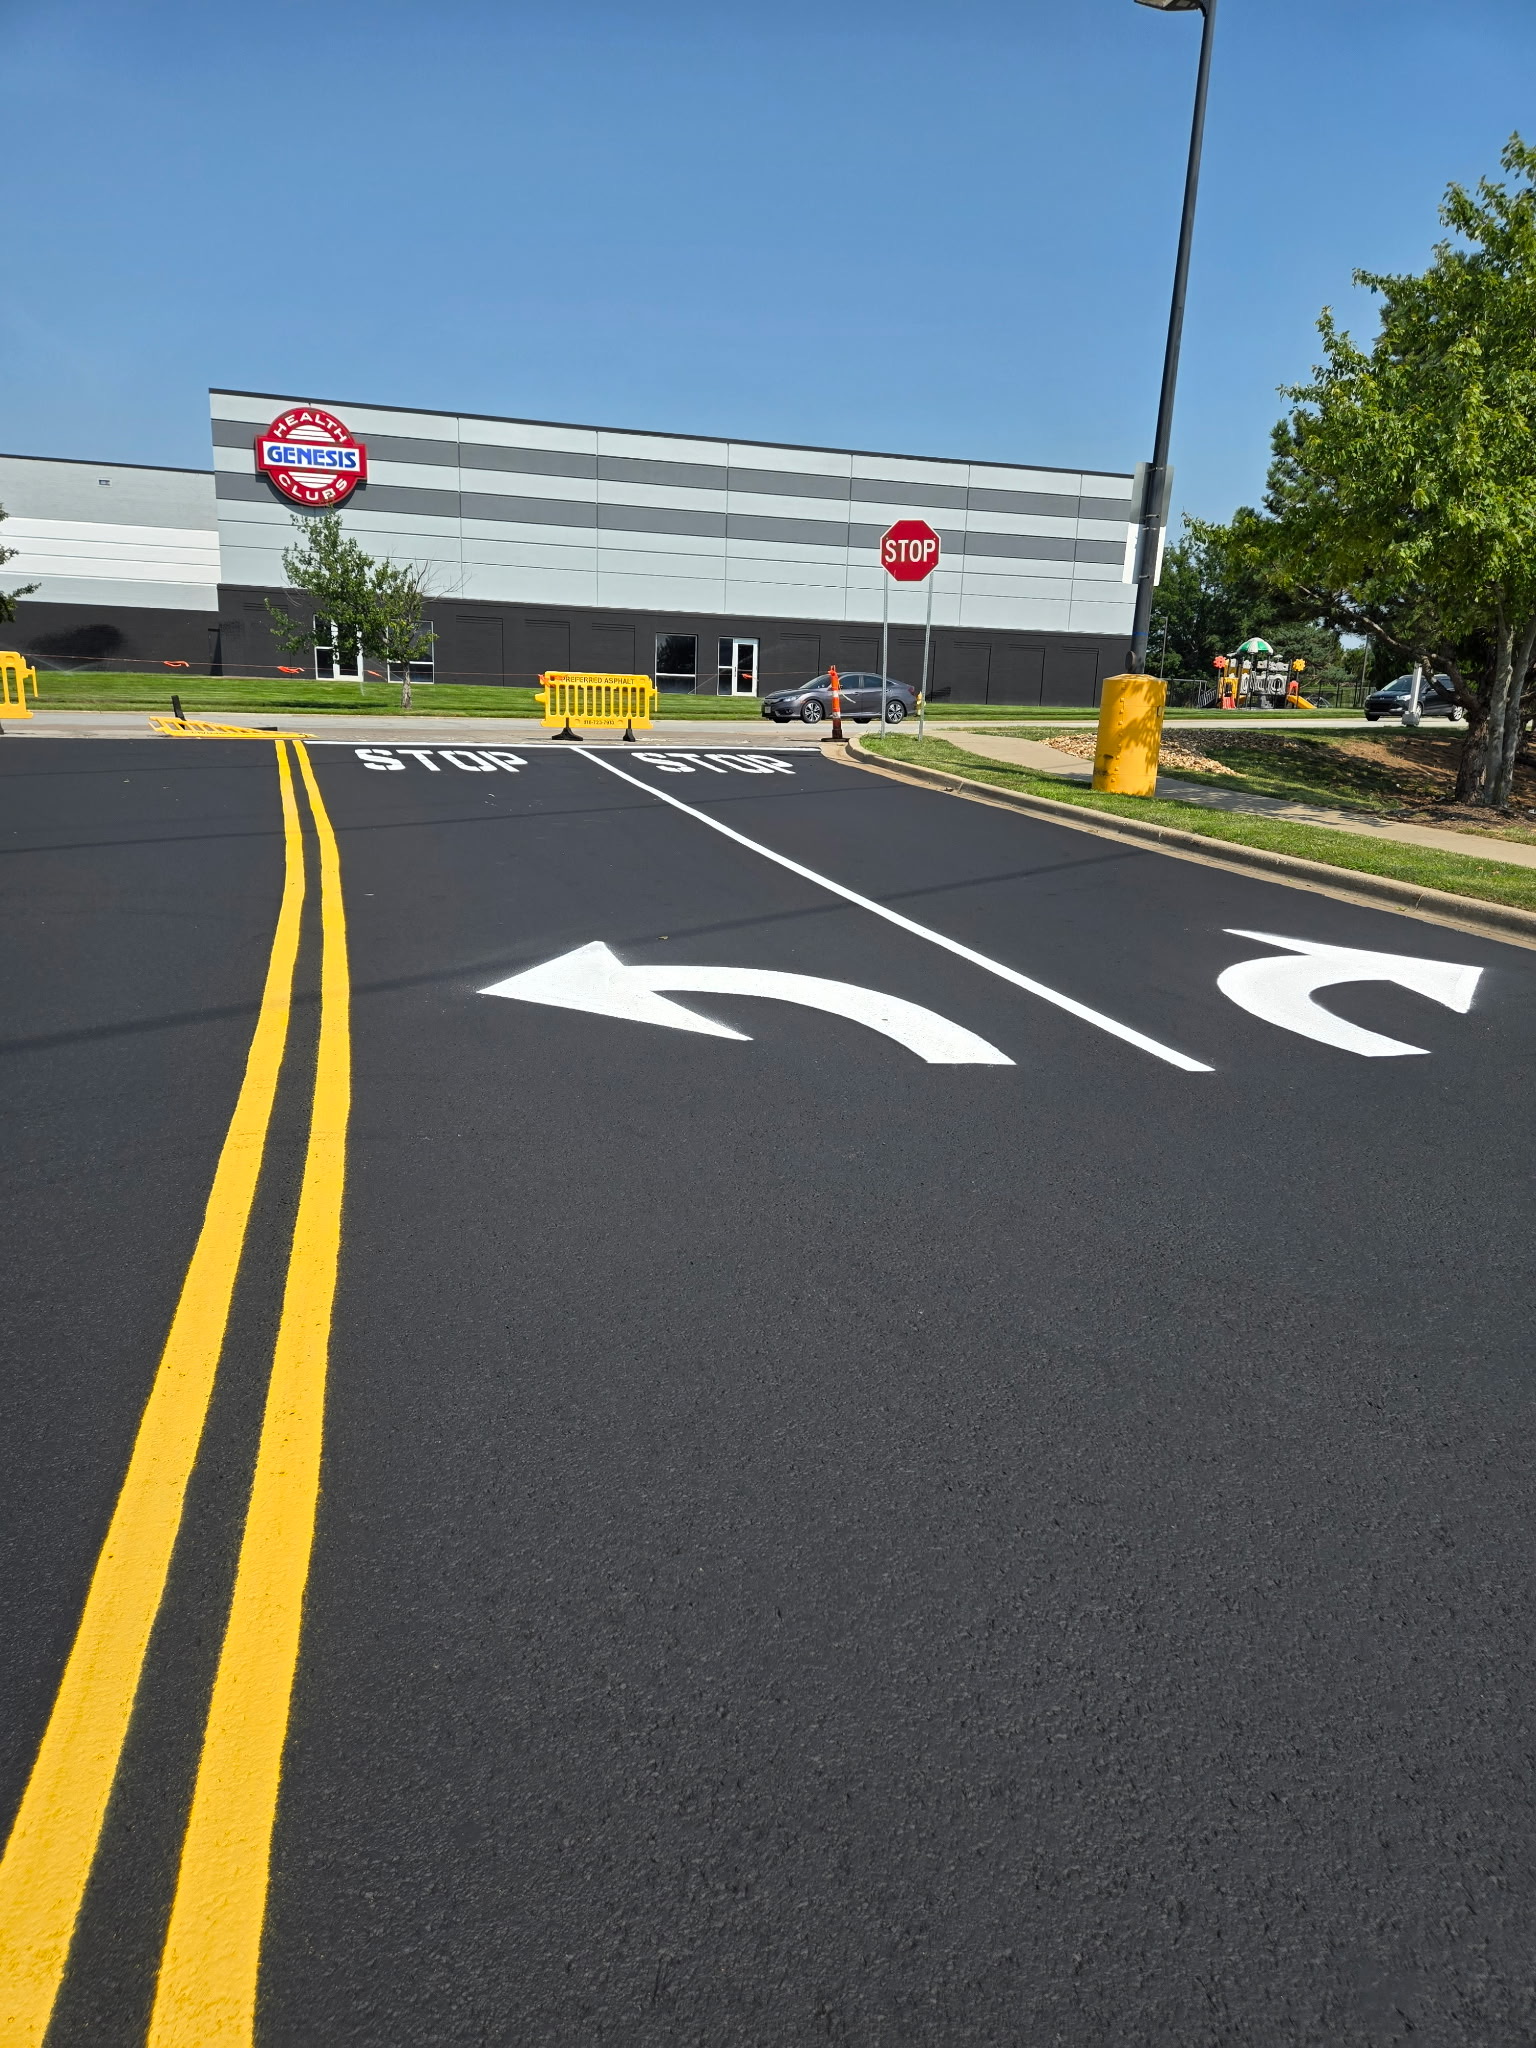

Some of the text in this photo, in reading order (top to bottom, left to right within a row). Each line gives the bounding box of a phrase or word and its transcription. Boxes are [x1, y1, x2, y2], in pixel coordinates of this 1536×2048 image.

[273, 412, 348, 442] HEALTH
[266, 445, 357, 468] GENESIS
[278, 473, 348, 500] CLUBS
[885, 539, 936, 562] STOP
[604, 677, 635, 685] ASPHALT
[354, 749, 528, 772] STOP
[631, 752, 796, 774] STOP
